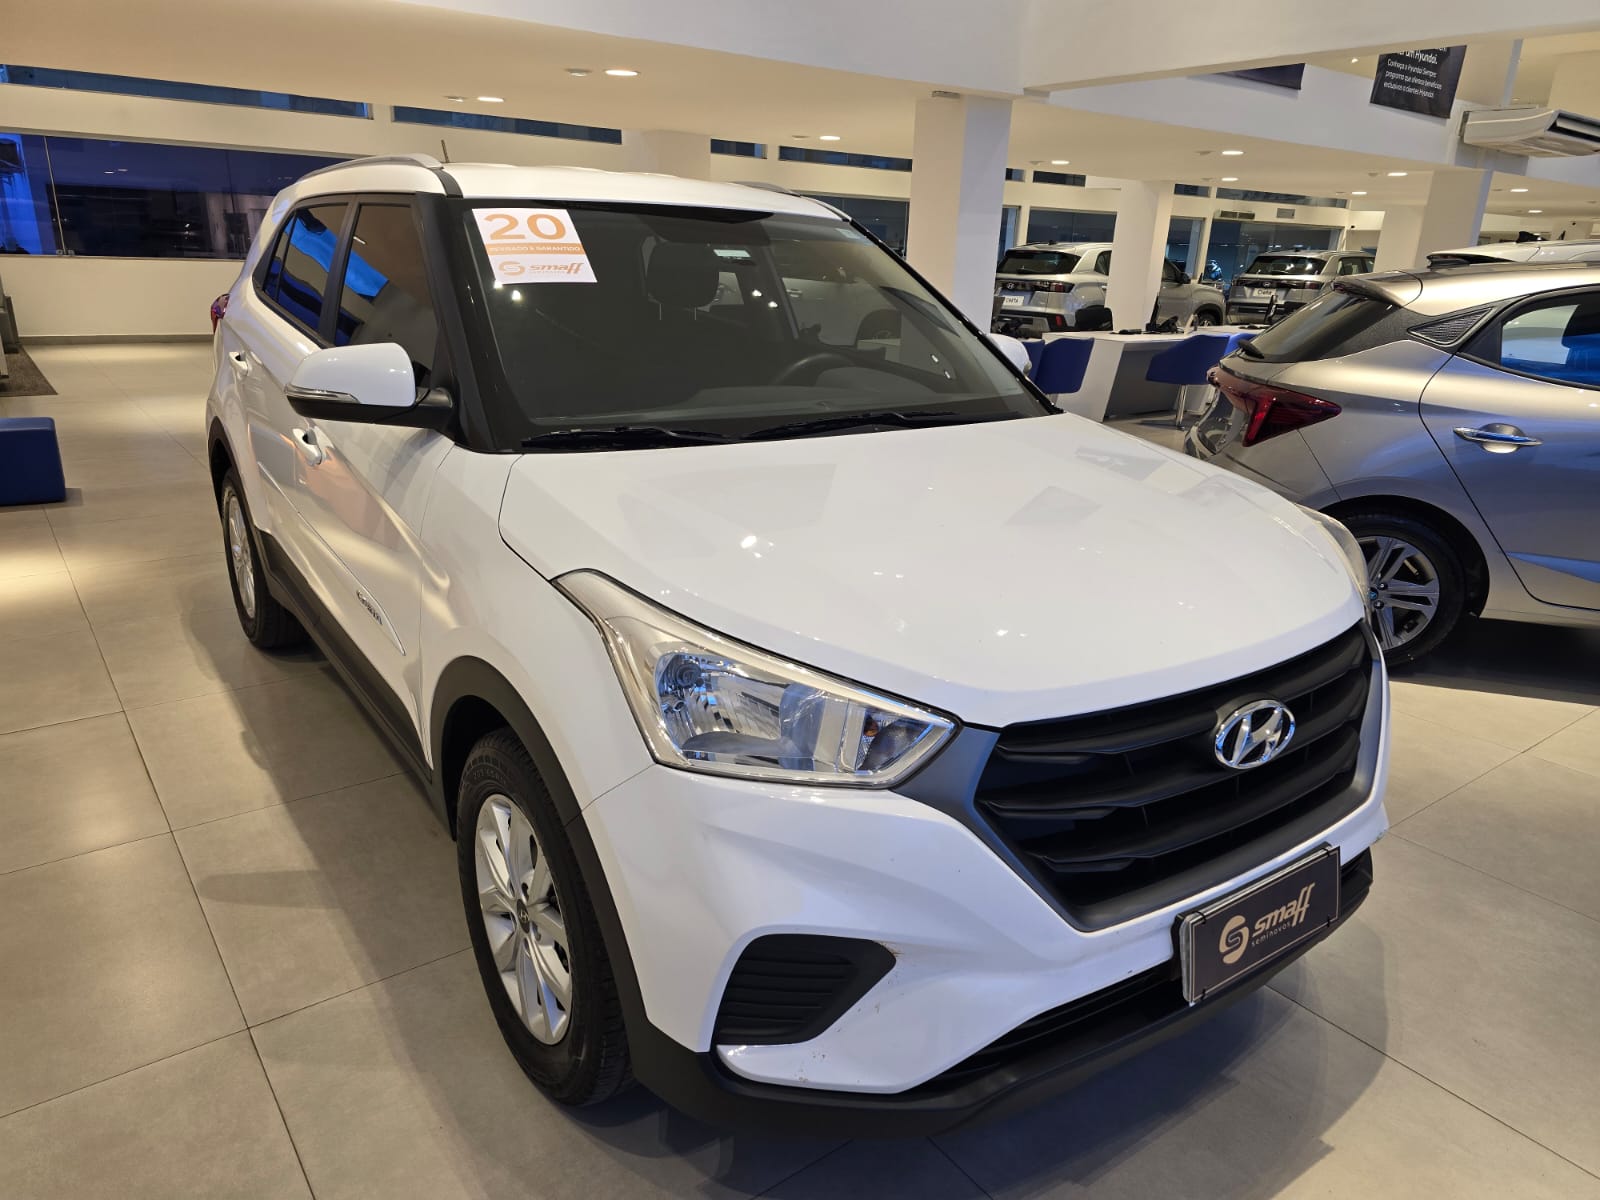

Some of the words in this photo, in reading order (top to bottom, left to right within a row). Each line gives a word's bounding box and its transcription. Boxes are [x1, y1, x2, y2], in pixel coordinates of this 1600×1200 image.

[484, 213, 566, 241] 20
[1252, 882, 1315, 938] smaff
[1251, 921, 1291, 947] seminovos
